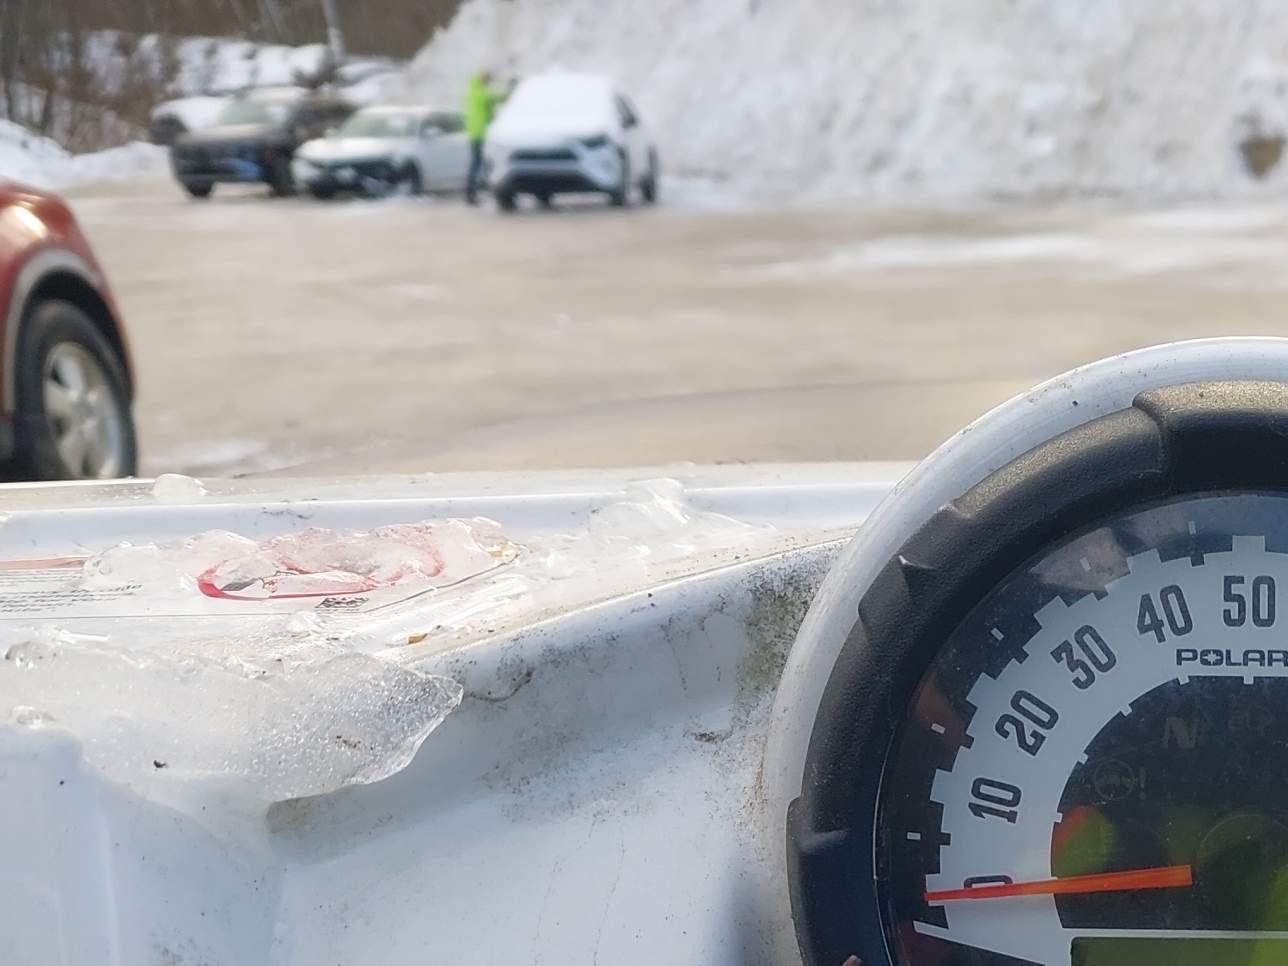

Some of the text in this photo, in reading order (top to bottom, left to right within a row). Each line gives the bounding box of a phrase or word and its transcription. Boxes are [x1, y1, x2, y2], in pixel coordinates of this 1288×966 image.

[1137, 584, 1193, 644] 40
[1223, 575, 1276, 628] 50
[1050, 625, 1117, 690] 30
[994, 690, 1059, 757] 20
[968, 777, 1022, 824] 10
